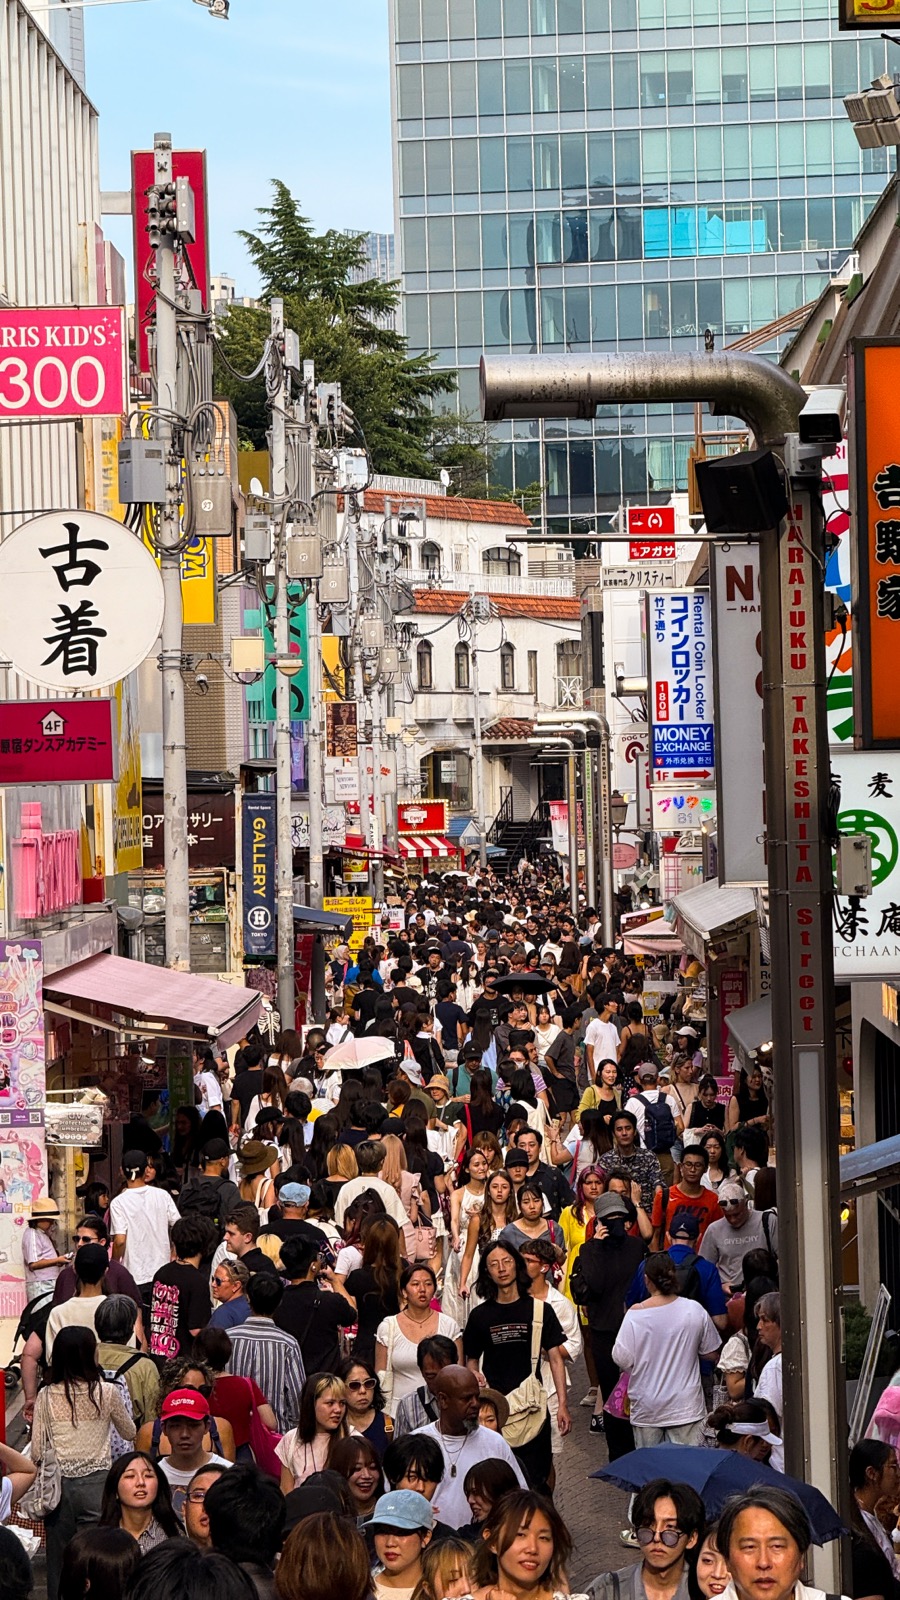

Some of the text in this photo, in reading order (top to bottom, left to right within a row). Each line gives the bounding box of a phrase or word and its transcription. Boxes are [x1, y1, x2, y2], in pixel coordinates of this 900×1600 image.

[0, 325, 106, 347] RIS KID'S
[0, 356, 106, 409] 300
[632, 513, 645, 521] 2F
[640, 546, 675, 556] アガサ
[629, 571, 672, 586] クリスティー
[726, 565, 761, 601] N
[38, 522, 110, 676] 古着
[654, 597, 665, 642] 竹下通り
[671, 596, 690, 721] コインロッカー
[693, 596, 706, 720] Rental Coin Locker
[45, 721, 61, 732] 4F
[655, 727, 711, 741] MONEY
[655, 742, 711, 752] EXCHANGE
[656, 770, 669, 780] 1F
[787, 504, 815, 1031] HARAJUKU TAKESHITA Street
[868, 772, 893, 798] 麦
[253, 817, 266, 898] GALLERY
[724, 1235, 759, 1246] GIVENCHY
[171, 1398, 195, 1406] Supreme
